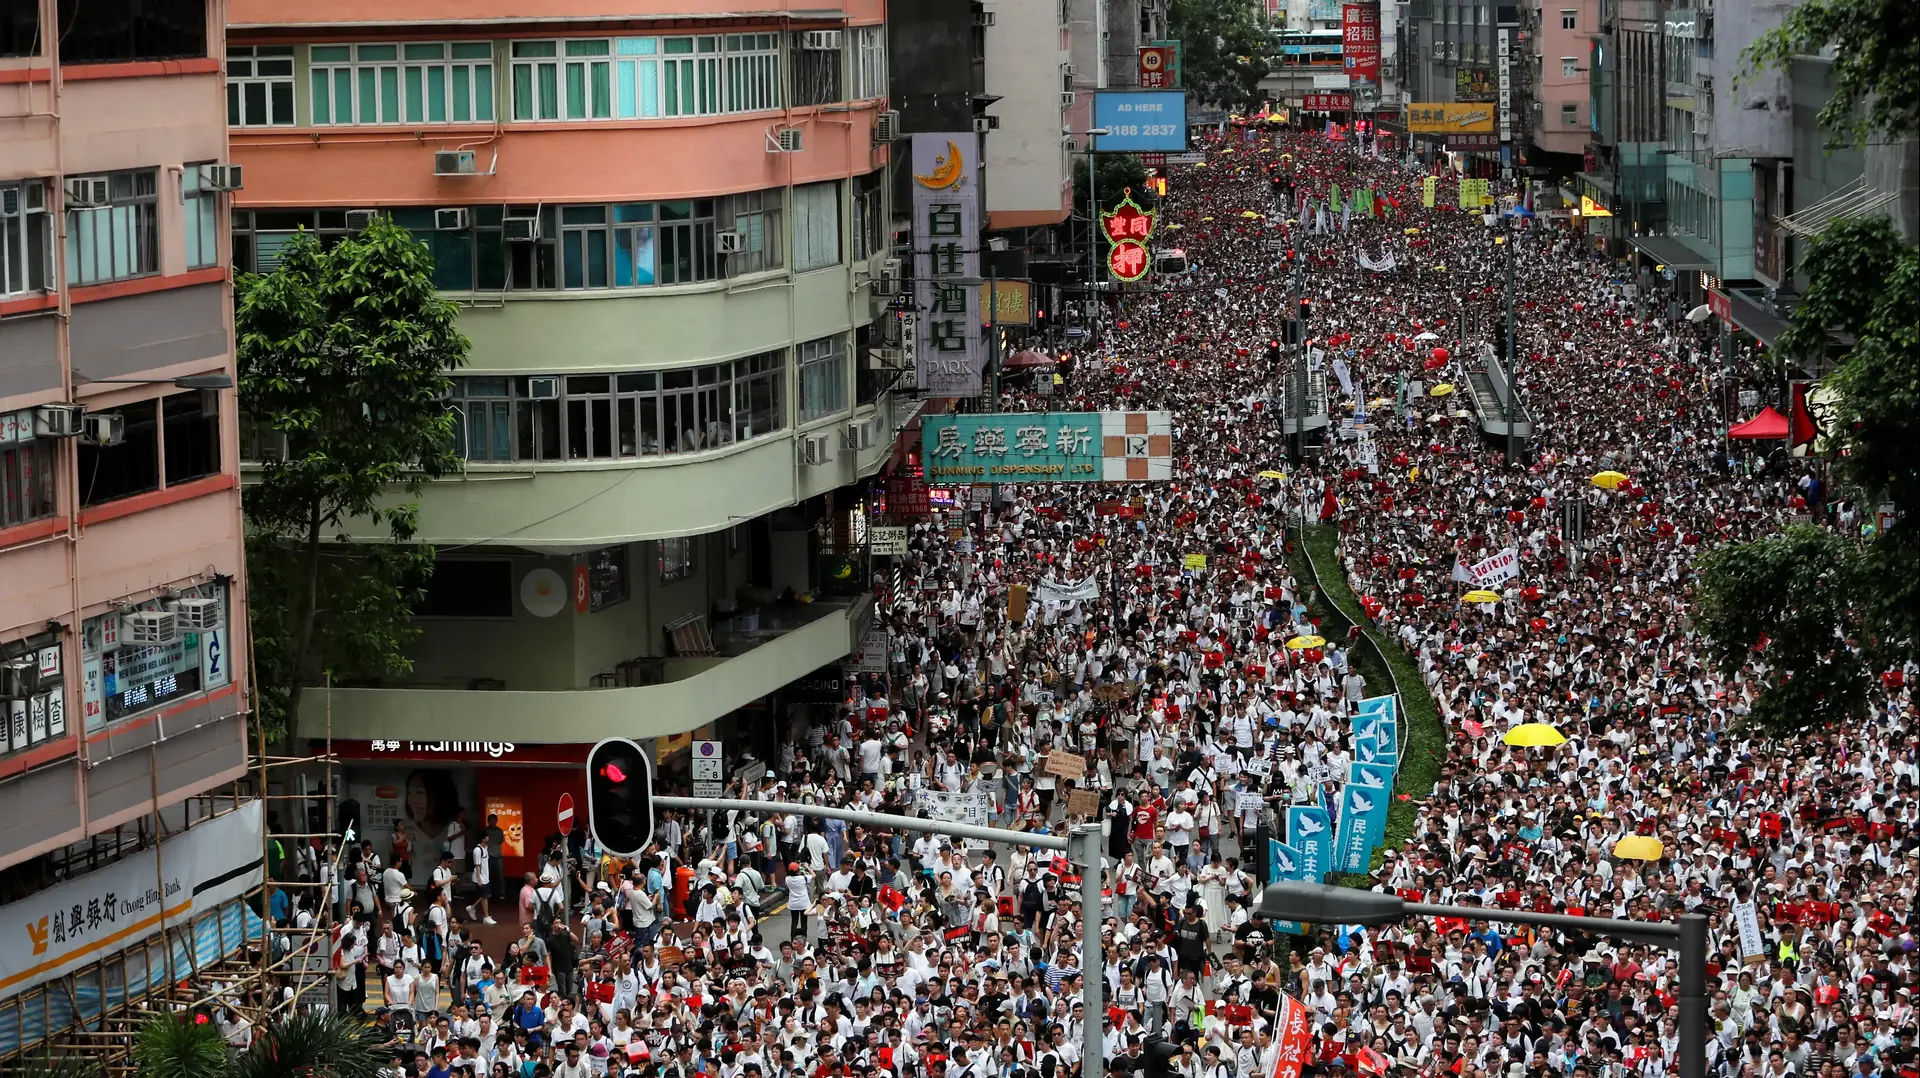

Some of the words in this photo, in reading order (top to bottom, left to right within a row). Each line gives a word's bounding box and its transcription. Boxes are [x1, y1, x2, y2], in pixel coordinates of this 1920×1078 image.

[1346, 8, 1375, 23] 廣告
[1346, 26, 1375, 41] 招租
[1118, 104, 1132, 112] AD
[1135, 104, 1163, 112] HERE
[1105, 125, 1138, 136] 3188
[1143, 125, 1176, 136] 2837
[929, 203, 967, 352] 百佳酒店
[927, 360, 971, 375] PARK
[930, 465, 986, 476] SUNNING
[990, 464, 1065, 475] DISPENSARY
[41, 653, 52, 668] 1/F
[120, 896, 144, 916] Chong
[165, 878, 182, 898] Bank
